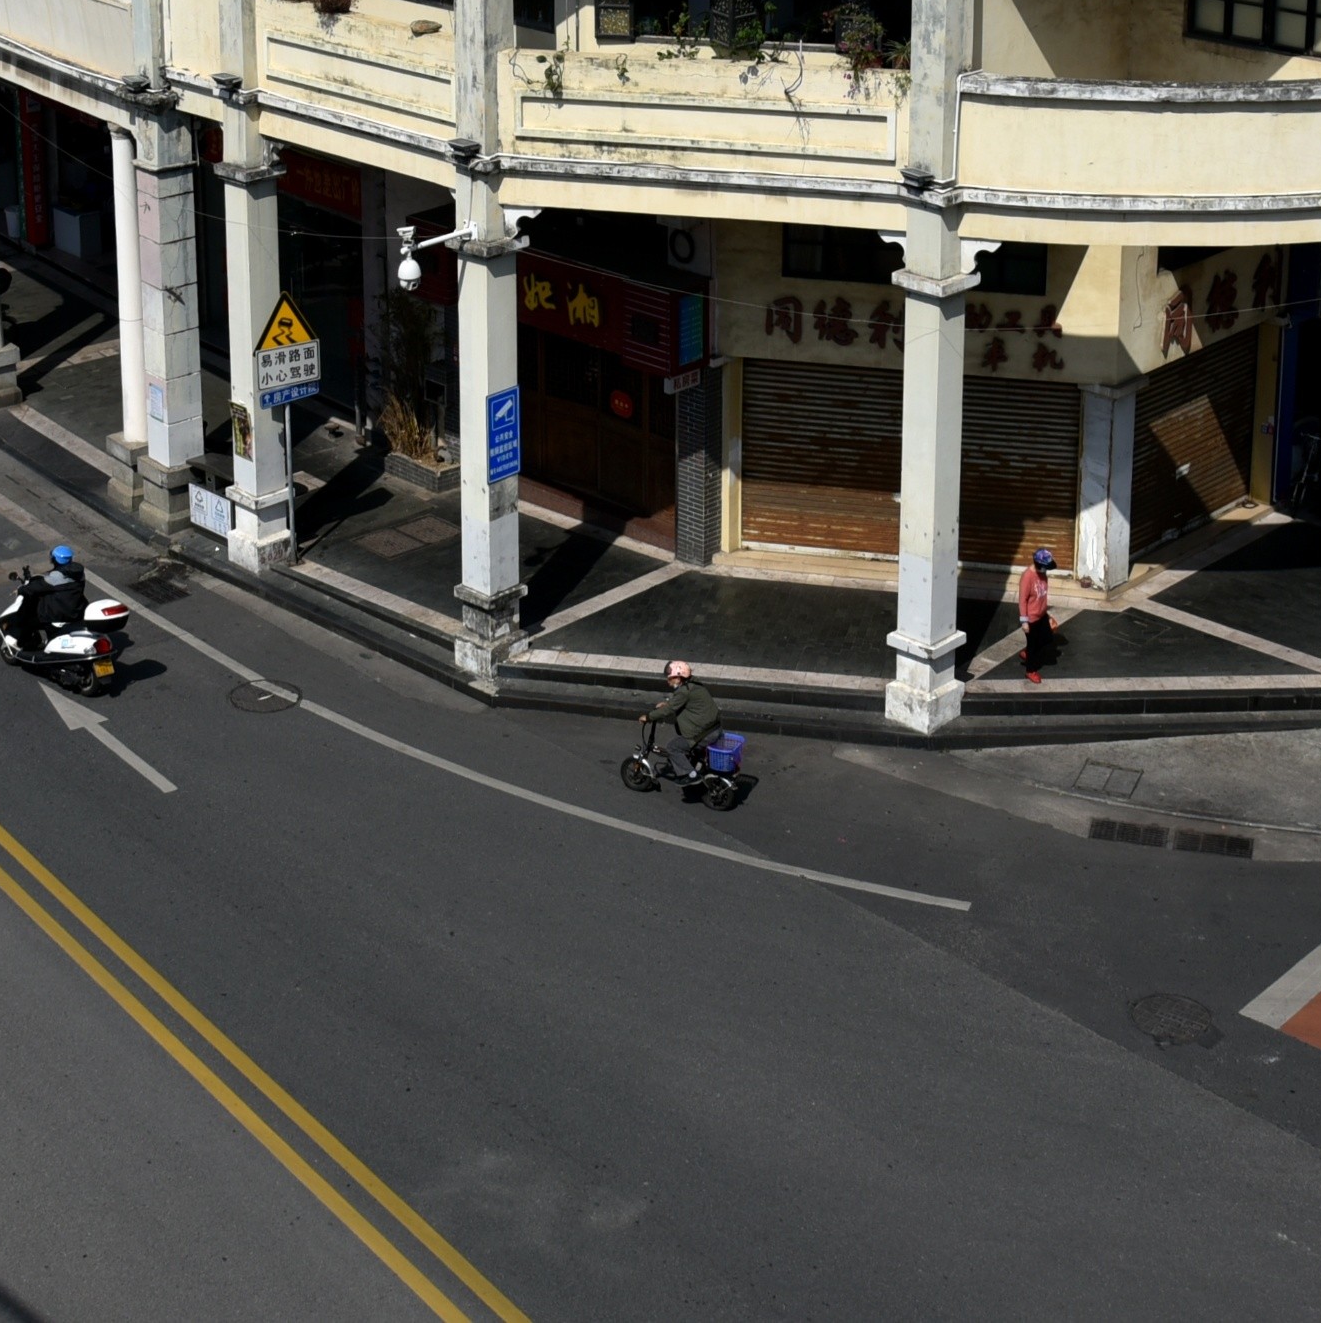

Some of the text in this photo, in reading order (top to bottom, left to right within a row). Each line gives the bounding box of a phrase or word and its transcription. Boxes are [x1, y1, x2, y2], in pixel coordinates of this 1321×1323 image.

[261, 346, 315, 368] 易滑路面
[261, 363, 316, 386] 小心驾驶
